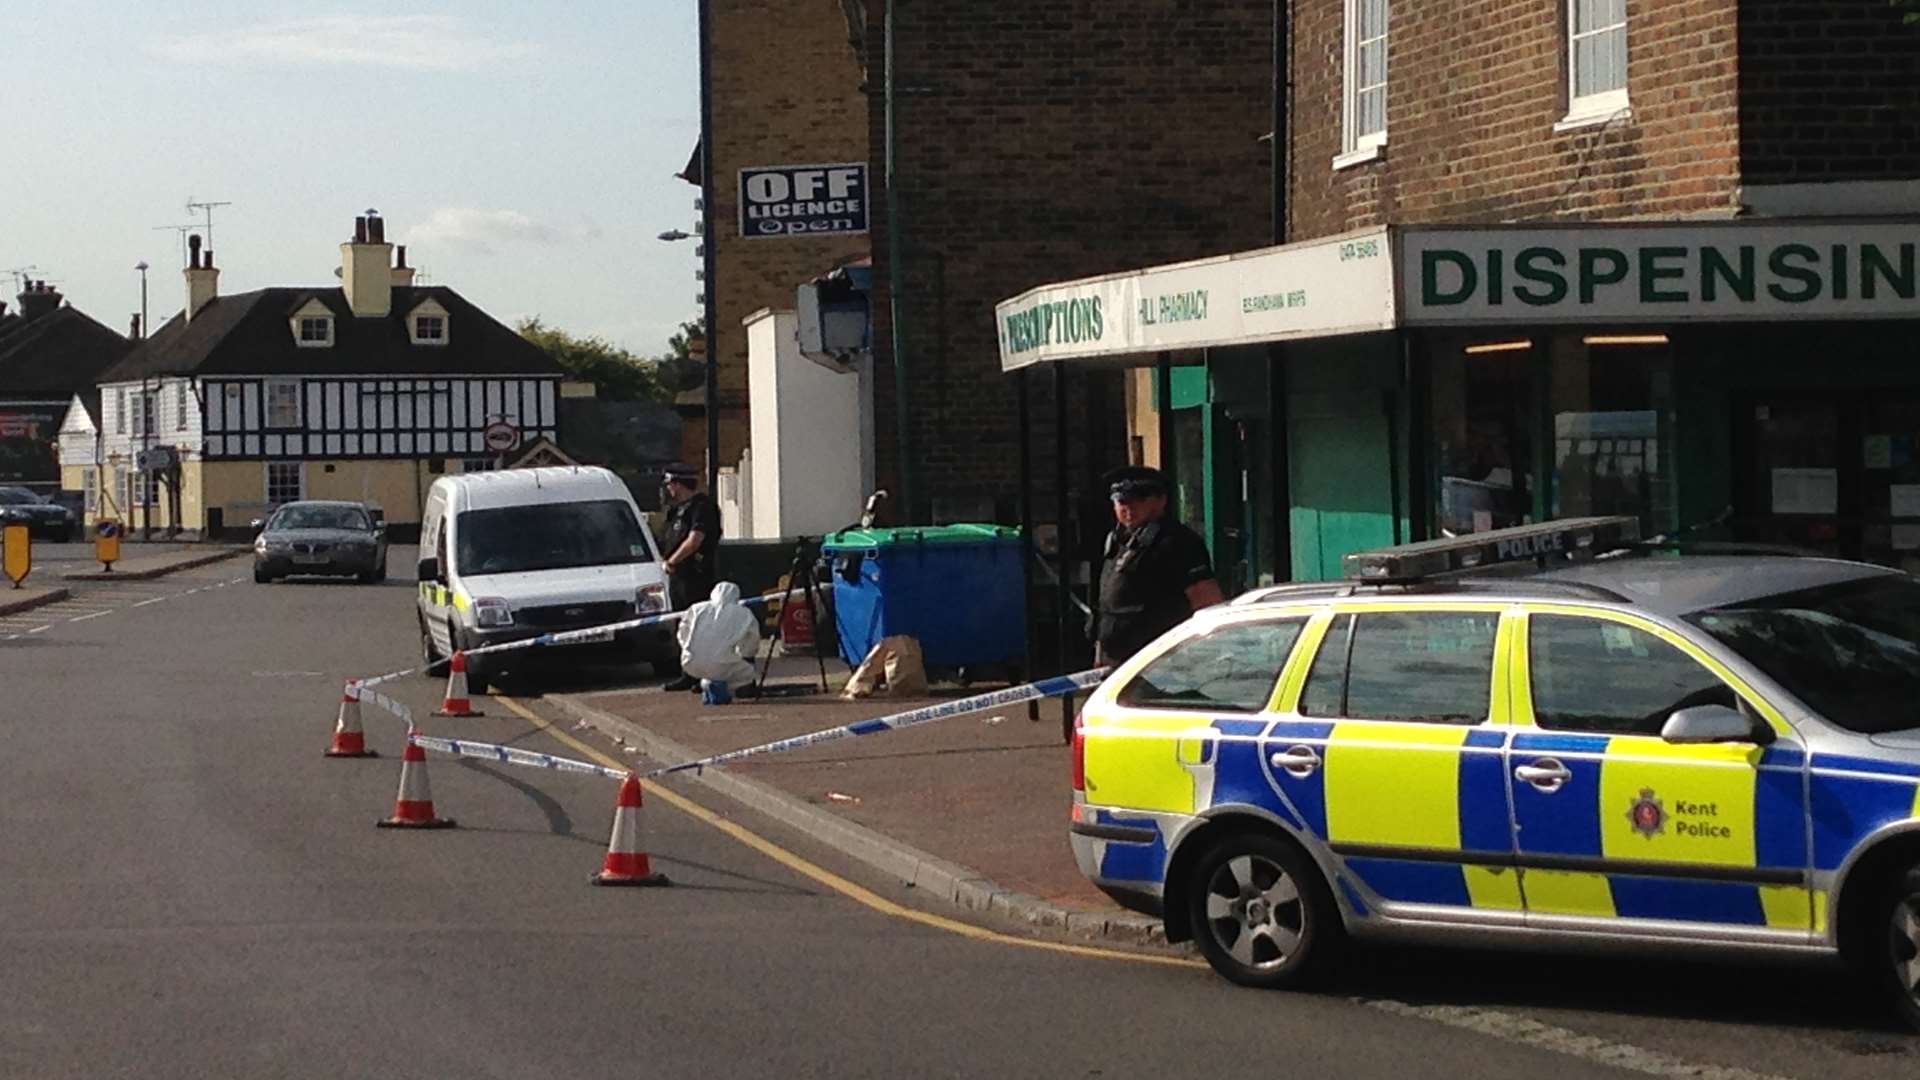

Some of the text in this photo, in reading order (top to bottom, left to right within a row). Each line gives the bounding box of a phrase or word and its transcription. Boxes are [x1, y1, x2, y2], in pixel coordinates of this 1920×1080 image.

[747, 169, 859, 203] OFF
[748, 200, 860, 218] LICENCE
[758, 219, 853, 235] Open
[1159, 289, 1209, 324] PHARMACY
[1497, 532, 1564, 559] POLICE
[897, 687, 1032, 726] POLICE LINE DO NOT CROSS
[1676, 800, 1717, 815] Kent
[1676, 821, 1731, 838] Police
